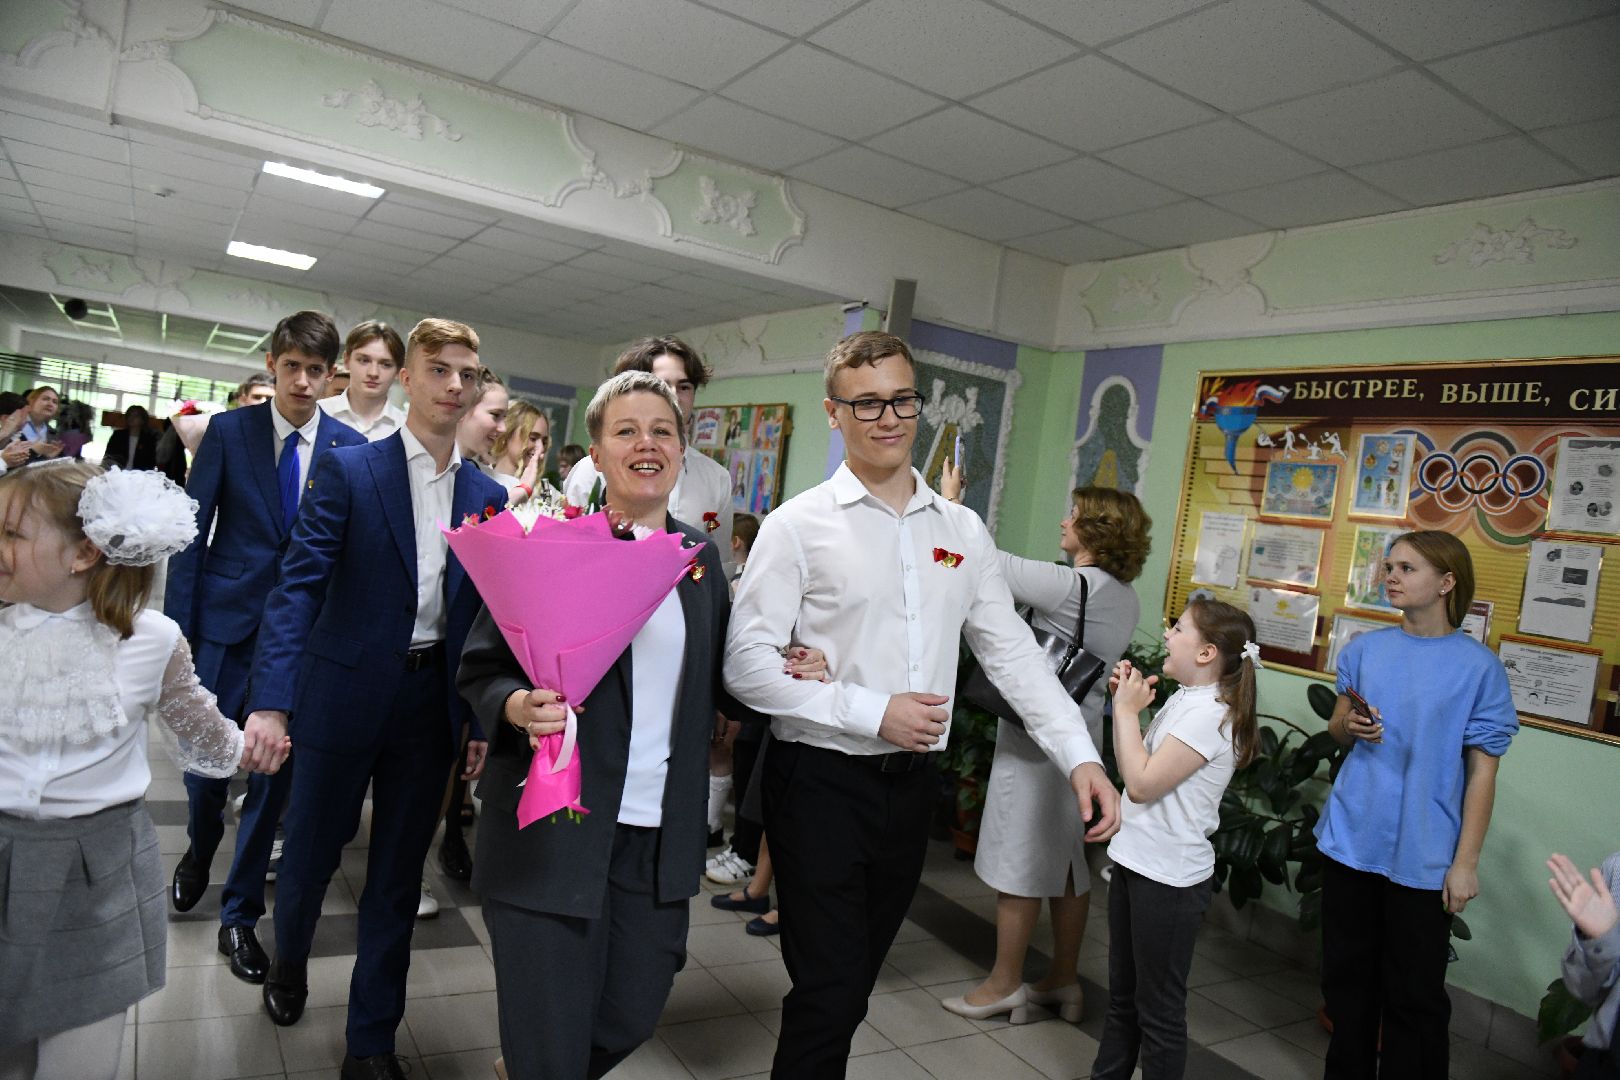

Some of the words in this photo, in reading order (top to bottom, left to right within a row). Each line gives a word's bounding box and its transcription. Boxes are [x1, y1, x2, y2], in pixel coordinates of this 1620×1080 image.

[1293, 378, 1425, 401] БЫСТРЕЕ,
[1439, 381, 1551, 407] ВЫШЕ,
[1569, 388, 1620, 411] СИ
